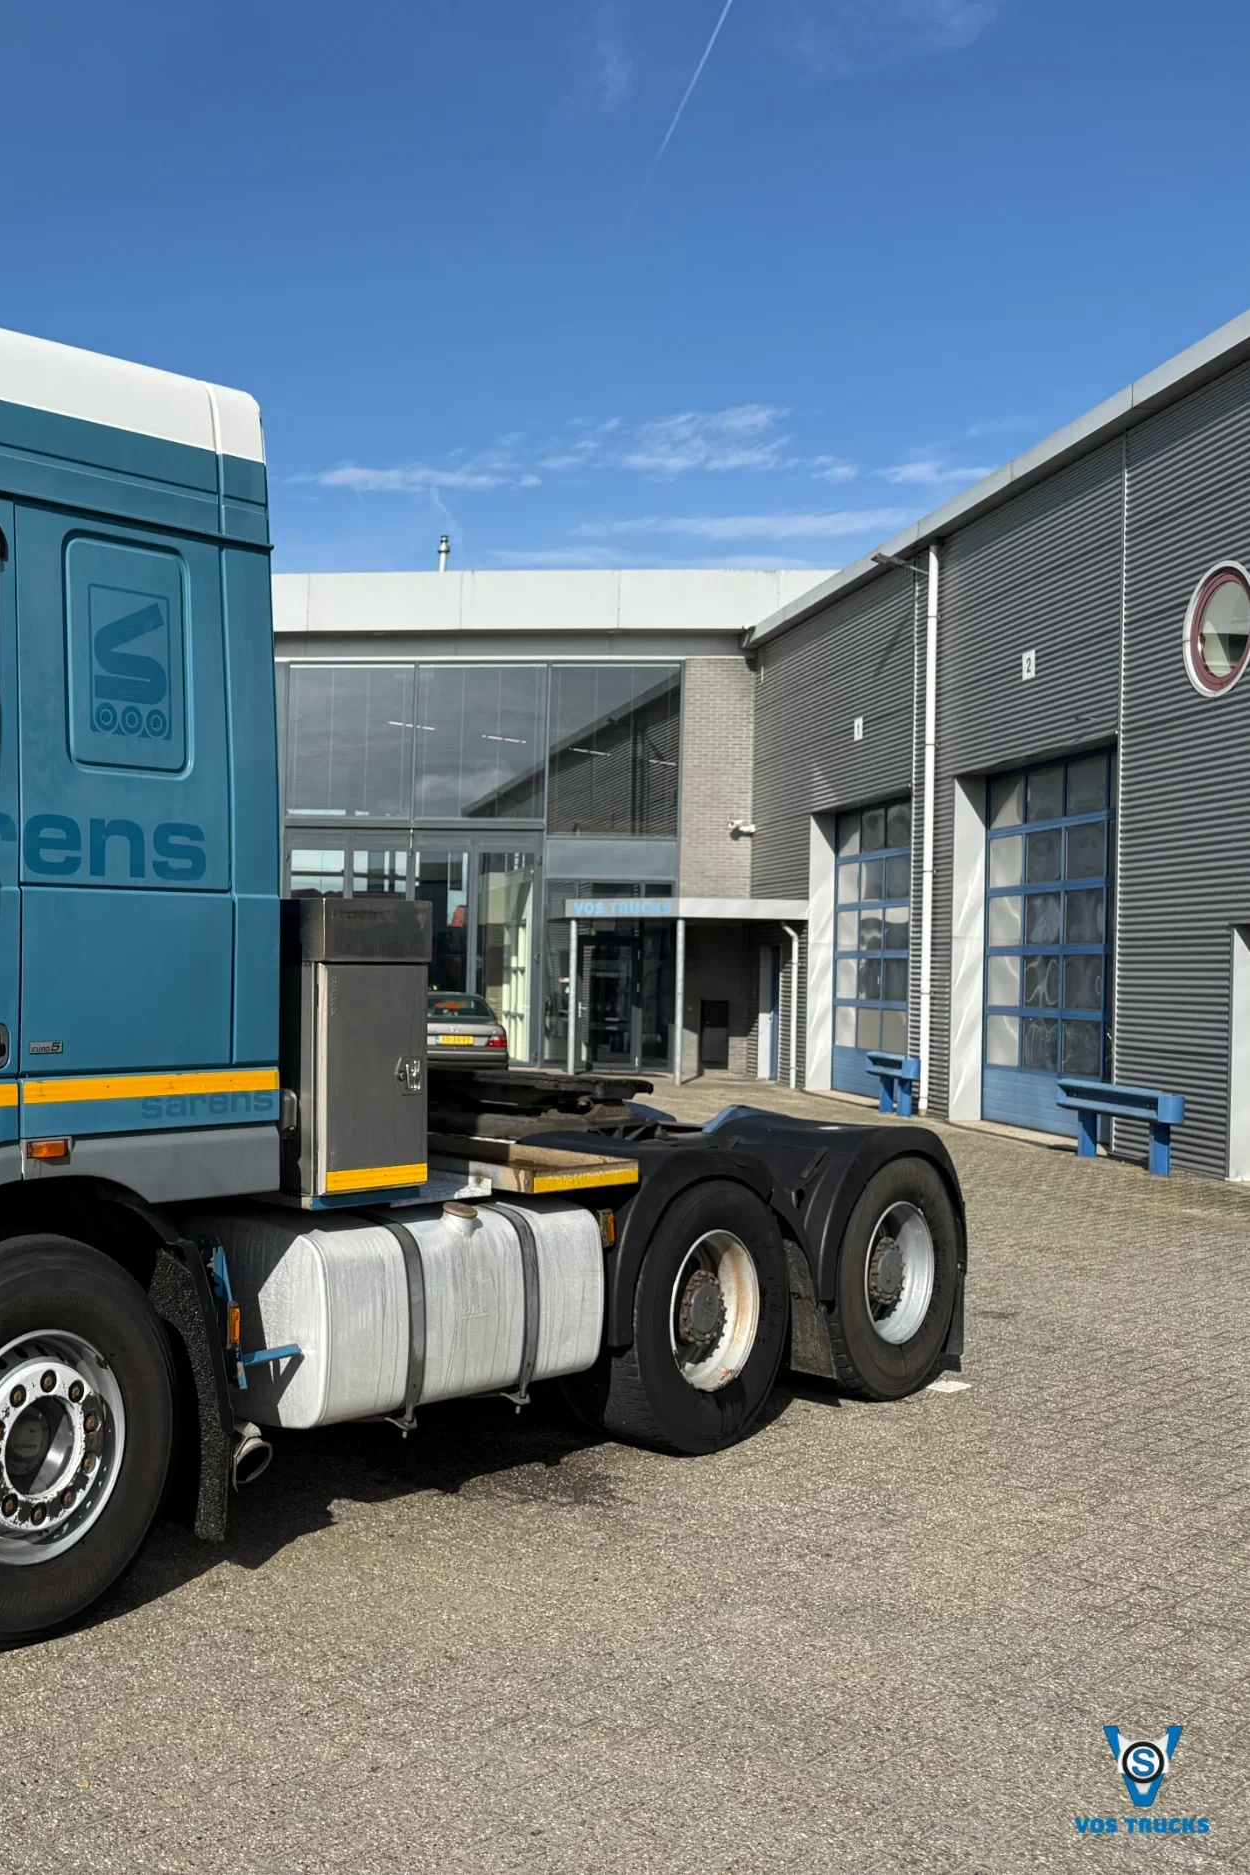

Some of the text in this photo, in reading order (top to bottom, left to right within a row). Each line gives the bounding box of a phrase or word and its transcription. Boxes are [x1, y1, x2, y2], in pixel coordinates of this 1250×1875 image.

[1025, 656, 1032, 673] 2
[573, 900, 673, 916] VOS TRUCKS
[141, 1089, 274, 1119] sarens
